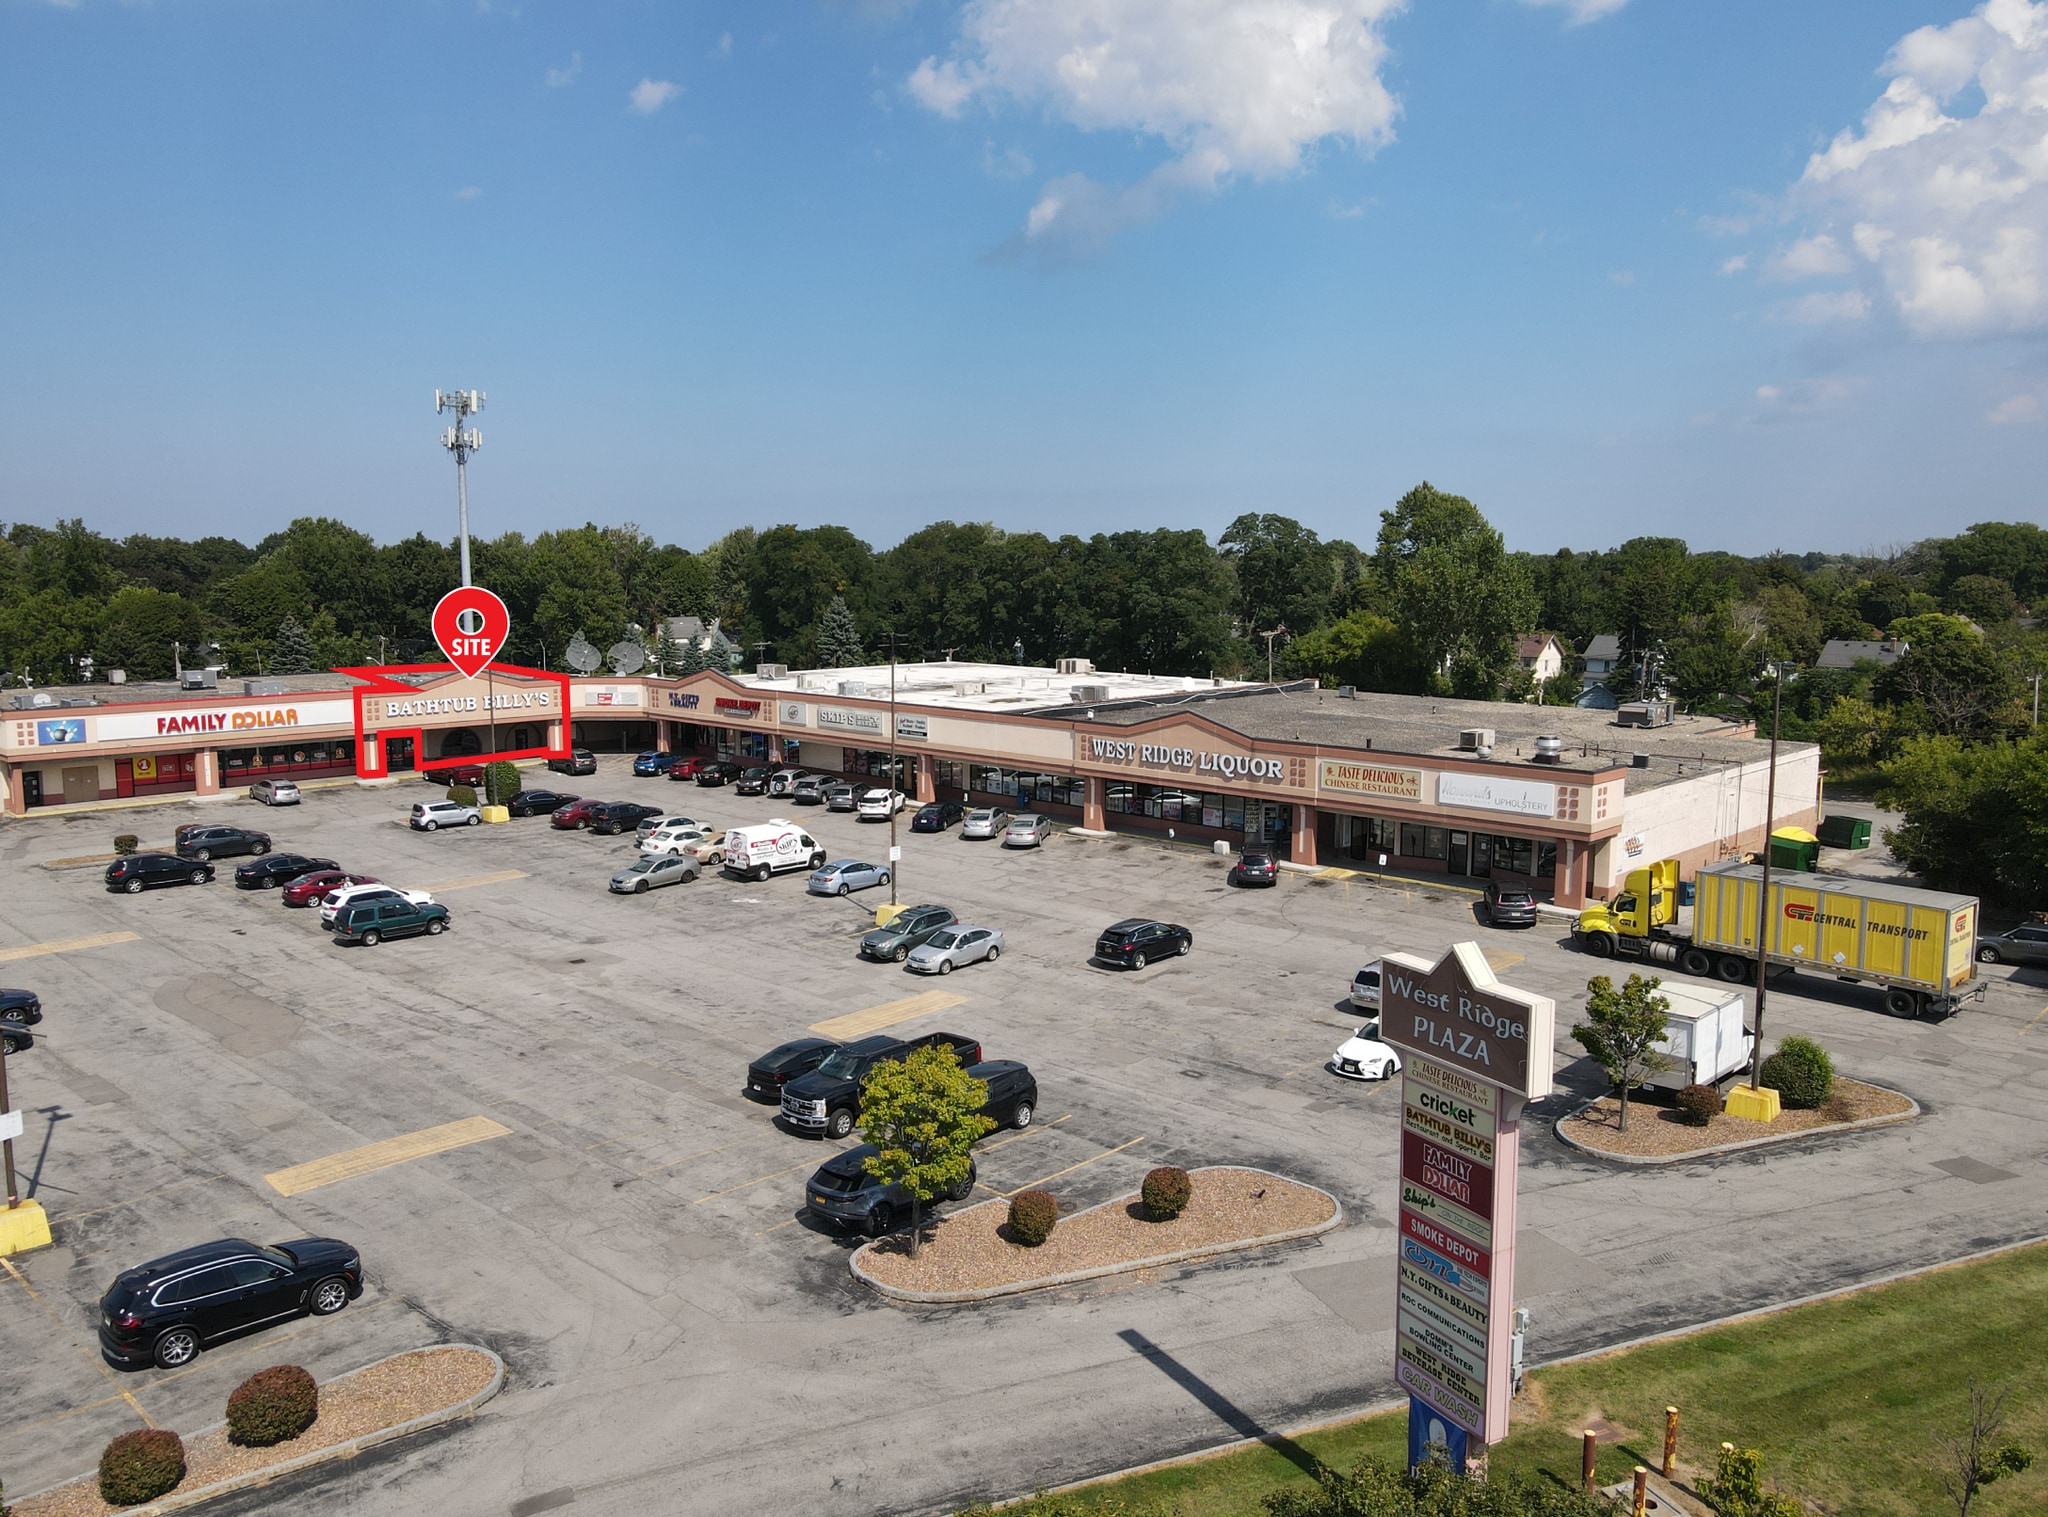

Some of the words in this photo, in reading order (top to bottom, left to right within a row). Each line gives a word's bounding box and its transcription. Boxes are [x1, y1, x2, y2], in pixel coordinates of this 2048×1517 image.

[157, 713, 226, 734] FAMILY
[232, 708, 299, 729] DOLLAR
[386, 697, 477, 718] BATHTUB
[484, 692, 550, 710] BILLY'S
[715, 697, 738, 709] SMOKE
[738, 700, 761, 711] DEPOT
[821, 711, 855, 725] SKIP'S
[1092, 739, 1136, 760] WEST
[1141, 743, 1194, 767] RIDGE
[1199, 751, 1284, 778] LIQUOR
[1338, 766, 1360, 780] TASTE
[1362, 768, 1404, 785] DELICIOUS
[1325, 778, 1360, 789] CHINESE
[1362, 783, 1418, 797] RESTAURANT
[1494, 798, 1548, 811] UPHOLSTERY
[1814, 912, 1856, 929] CENTRAL
[1866, 921, 1928, 940] TRANSPORT
[1387, 973, 1450, 1012] West
[1458, 997, 1525, 1040] Ridge
[1413, 1015, 1490, 1066] PLAZA
[1411, 1069, 1440, 1086] CHINESE
[1442, 1081, 1488, 1105] RESTAURANT
[1422, 1063, 1441, 1078] TASTE
[1442, 1071, 1477, 1094] DELICIOUS
[1420, 1092, 1475, 1127] cricket
[1406, 1107, 1451, 1135] BATHTUB
[1454, 1128, 1491, 1154] BILLY'S
[1406, 1119, 1439, 1138] Restaurant
[1442, 1134, 1453, 1145] and
[1454, 1140, 1477, 1155] Sports
[1479, 1151, 1491, 1161] Bar
[1423, 1143, 1472, 1181] FAMILY
[1423, 1164, 1470, 1204] DOLLAR
[1411, 1218, 1445, 1247] SMOKE
[1446, 1237, 1479, 1265] DEPOT
[1401, 1266, 1418, 1283] N.Y.
[1419, 1277, 1444, 1299] GIFTS
[1444, 1292, 1449, 1301] &
[1450, 1294, 1488, 1324] BEAUTY
[1401, 1292, 1416, 1307] ROC
[1417, 1303, 1485, 1349] COMMUNICATIONS
[1409, 1327, 1442, 1353] BOWLING
[1443, 1349, 1474, 1374] CENTER
[1425, 1329, 1454, 1352] DOMM'S
[1402, 1347, 1443, 1380] BEVERAGE
[1447, 1377, 1480, 1406] CENTER
[1415, 1346, 1437, 1366] WEST
[1441, 1363, 1467, 1386] RIDGE
[1402, 1366, 1432, 1397] CAR
[1434, 1387, 1479, 1428] WASH
